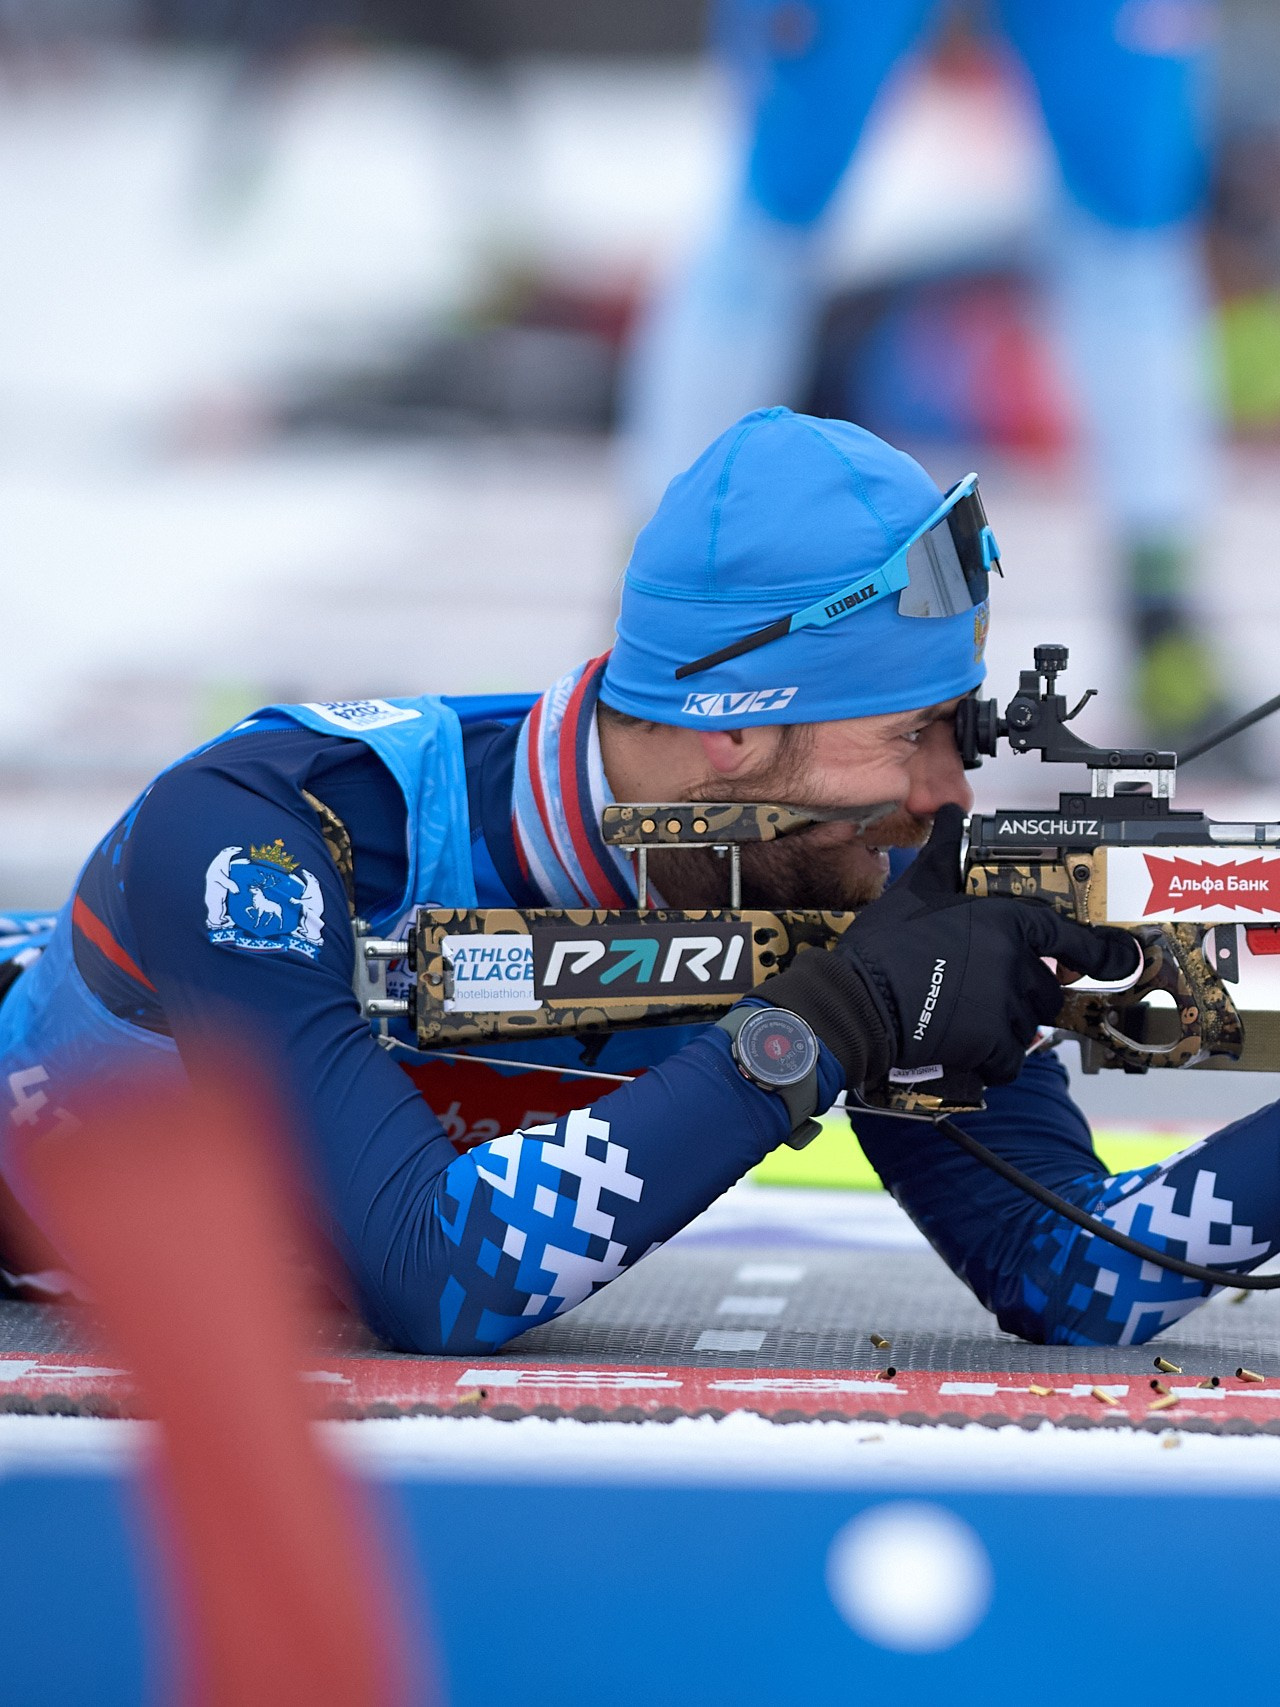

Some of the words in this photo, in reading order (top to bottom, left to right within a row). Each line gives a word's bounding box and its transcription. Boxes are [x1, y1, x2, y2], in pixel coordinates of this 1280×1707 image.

[843, 583, 879, 609] BLIZ
[1168, 875, 1224, 897] Альфа
[1227, 875, 1269, 892] Банк
[451, 947, 534, 963] ATHLON
[543, 935, 744, 986] PARI
[456, 988, 533, 1000] hotelbiathlon.r
[913, 958, 947, 1041] NORDSKI
